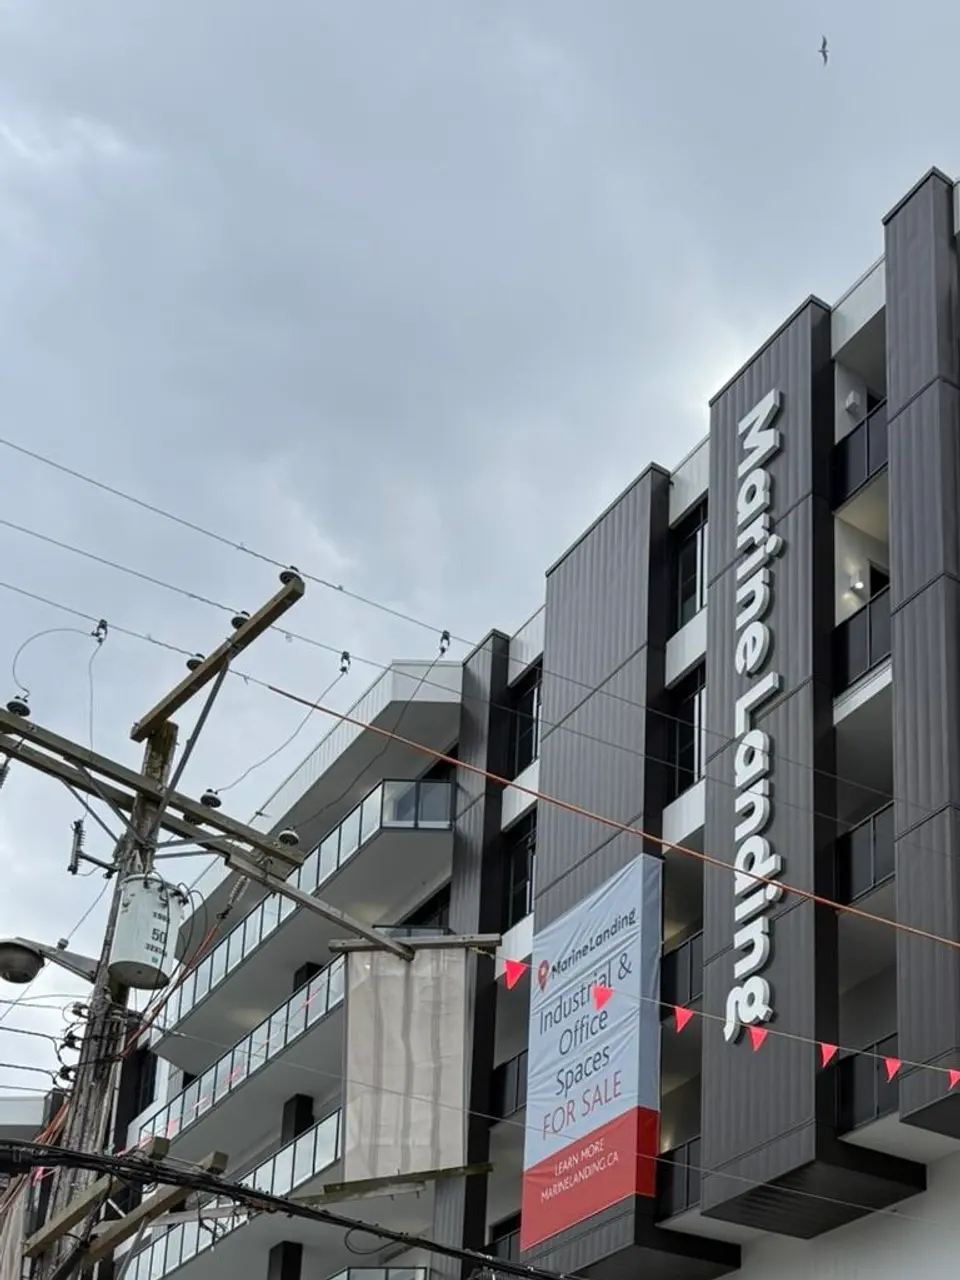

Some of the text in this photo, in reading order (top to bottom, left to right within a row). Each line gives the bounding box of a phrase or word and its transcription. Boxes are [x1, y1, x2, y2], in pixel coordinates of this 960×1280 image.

[551, 907, 636, 980] MarineLanding
[617, 952, 632, 980] &
[559, 1009, 609, 1056] Office
[555, 1045, 610, 1098] Spaces
[543, 1070, 622, 1141] FOR SALE
[540, 1150, 620, 1203] MARINELANDING.CA
[554, 1137, 605, 1177] LEARN MORE
